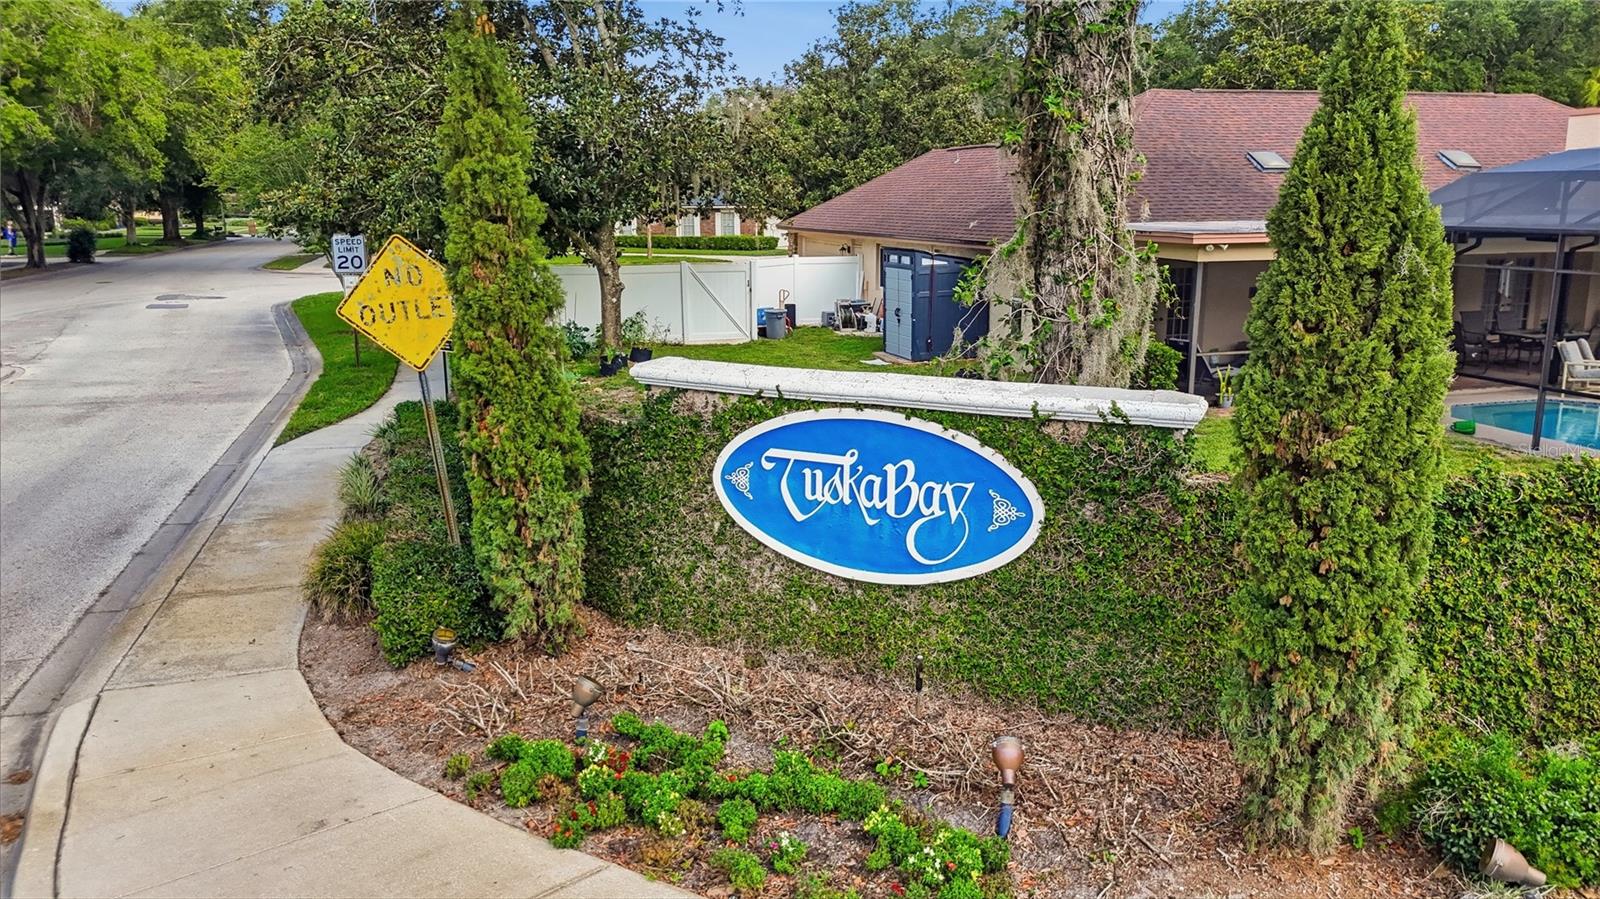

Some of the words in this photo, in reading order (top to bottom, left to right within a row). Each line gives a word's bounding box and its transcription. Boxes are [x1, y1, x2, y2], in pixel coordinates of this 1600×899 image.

[334, 238, 362, 246] SPEED
[338, 246, 359, 254] LIMIT
[337, 255, 363, 270] 20
[384, 264, 423, 288] NO
[359, 295, 450, 326] OUTLE
